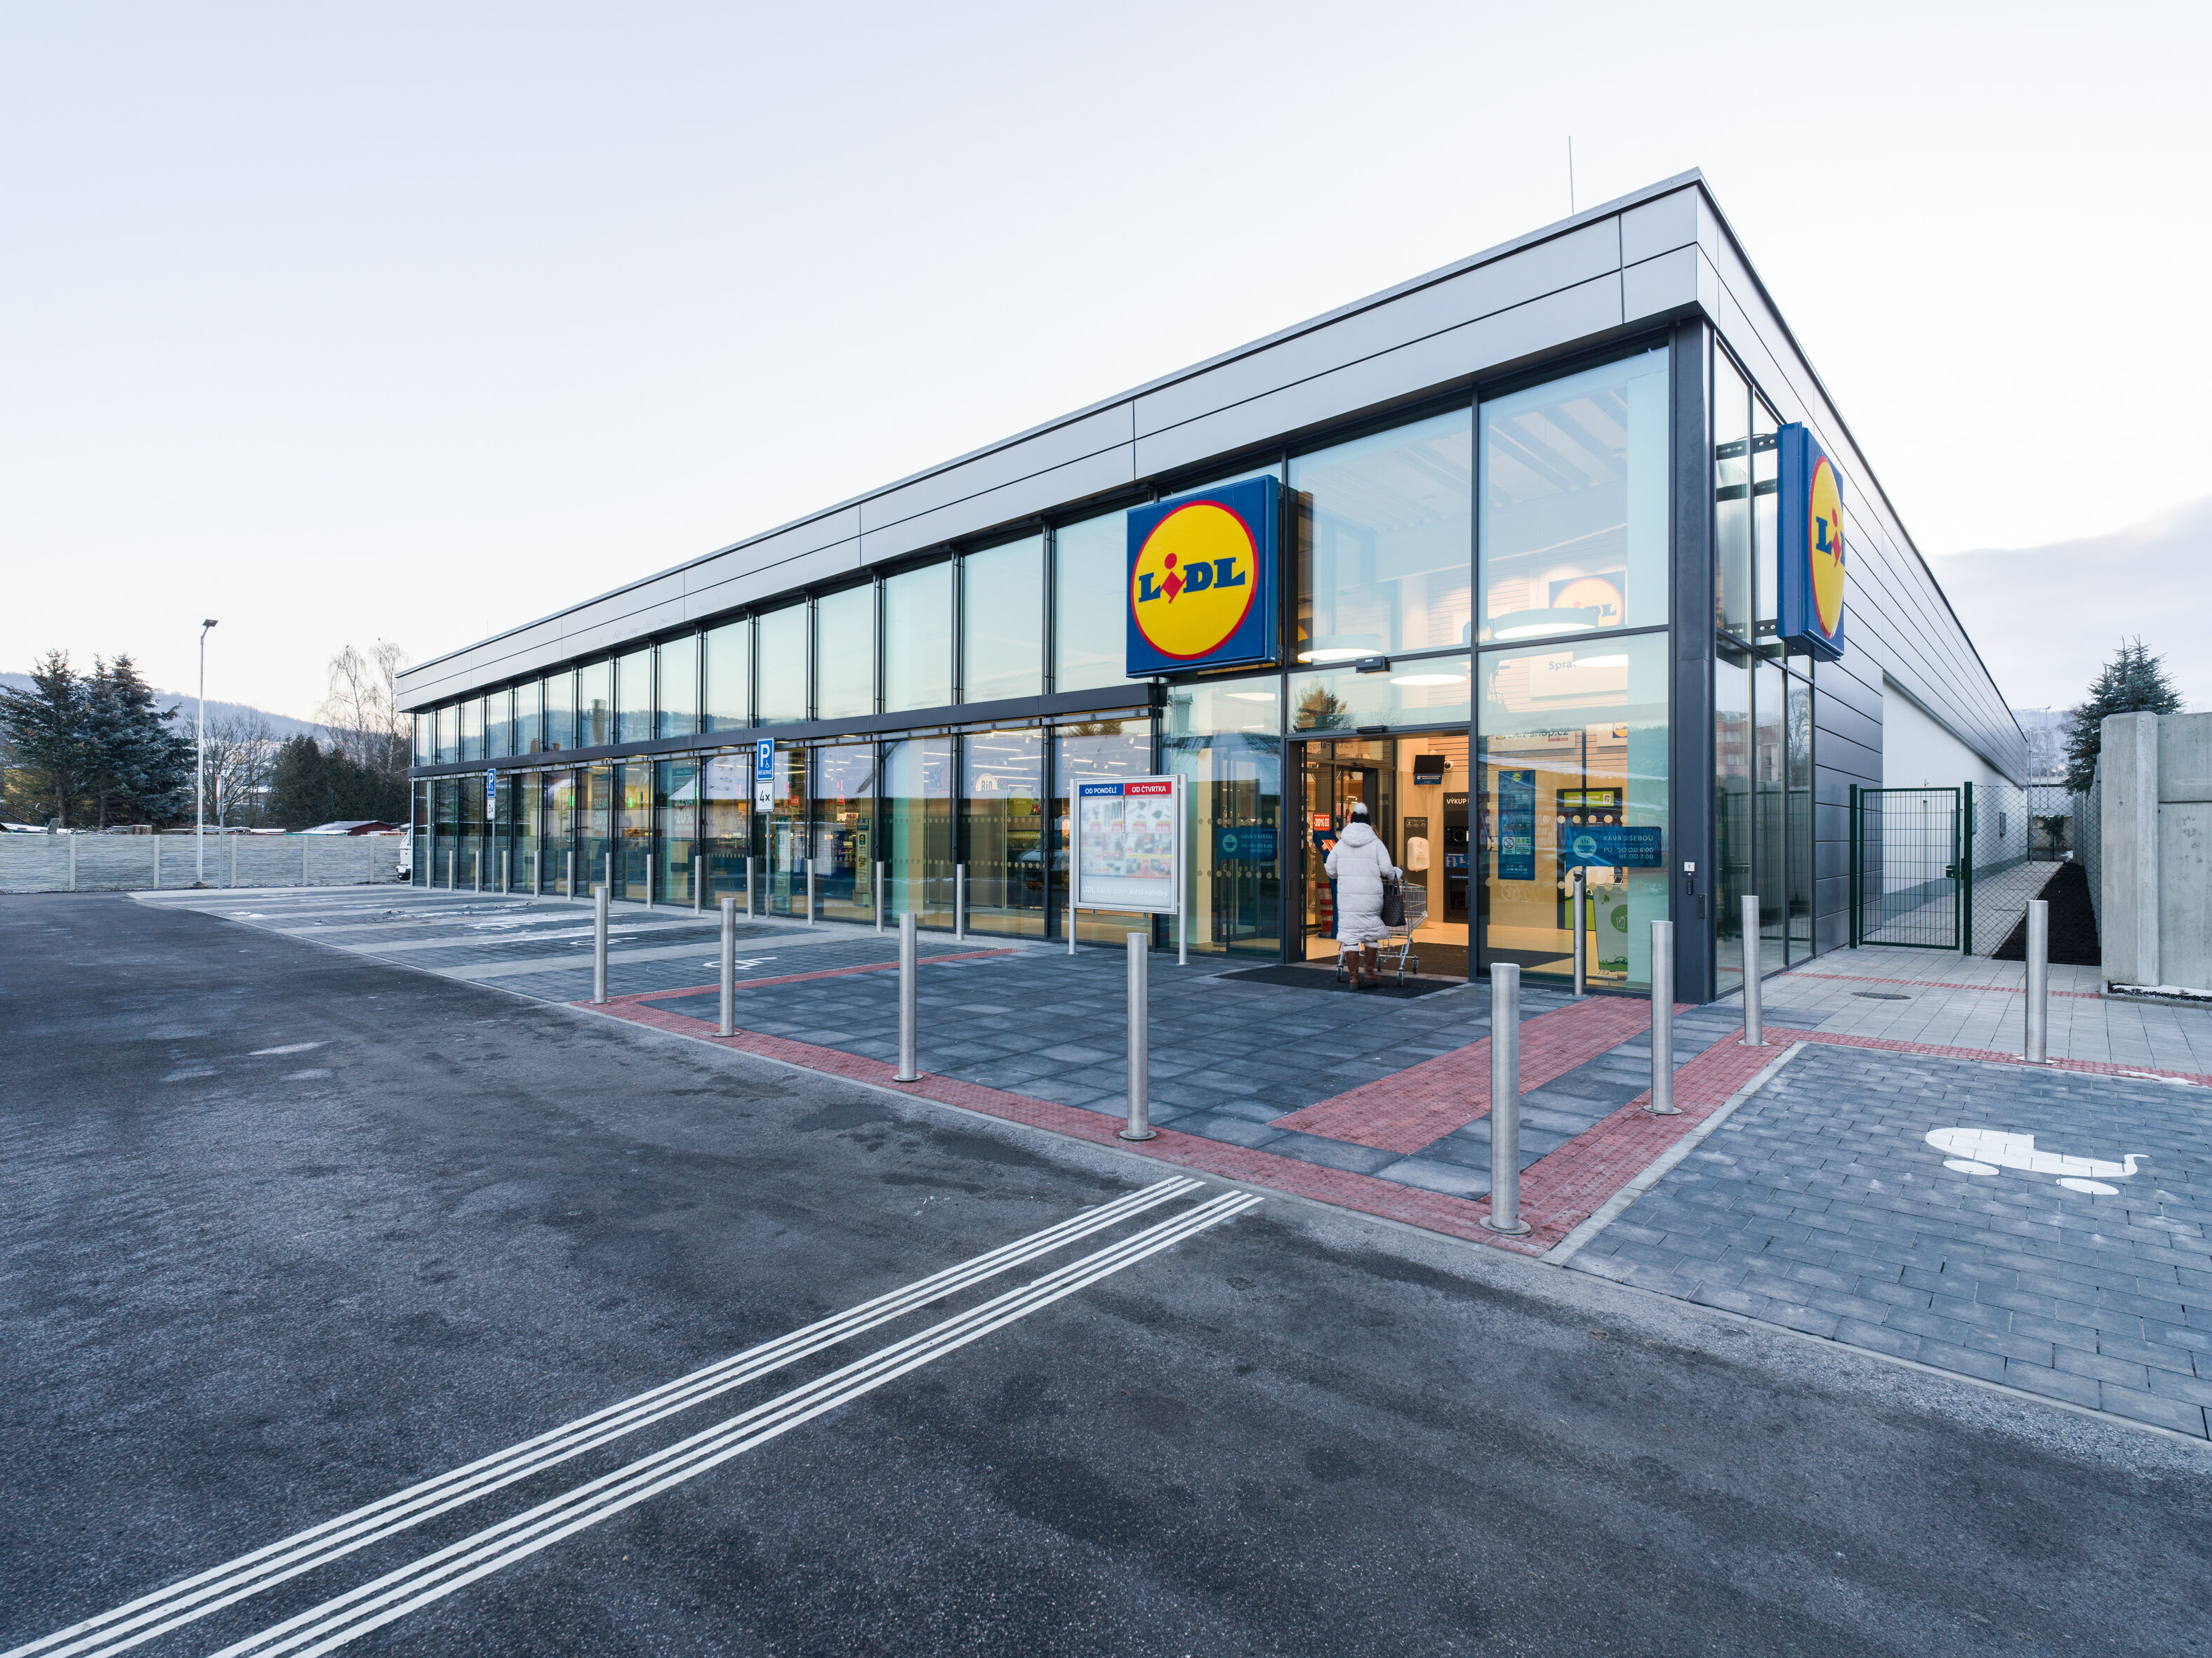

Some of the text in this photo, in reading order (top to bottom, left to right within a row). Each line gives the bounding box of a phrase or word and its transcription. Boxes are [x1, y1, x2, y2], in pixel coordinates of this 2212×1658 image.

[1138, 552, 1245, 604] LIDL
[760, 744, 770, 767] P
[489, 773, 494, 789] P
[760, 790, 770, 802] 4x
[674, 808, 694, 824] -20%
[1313, 818, 1325, 827] -20%
